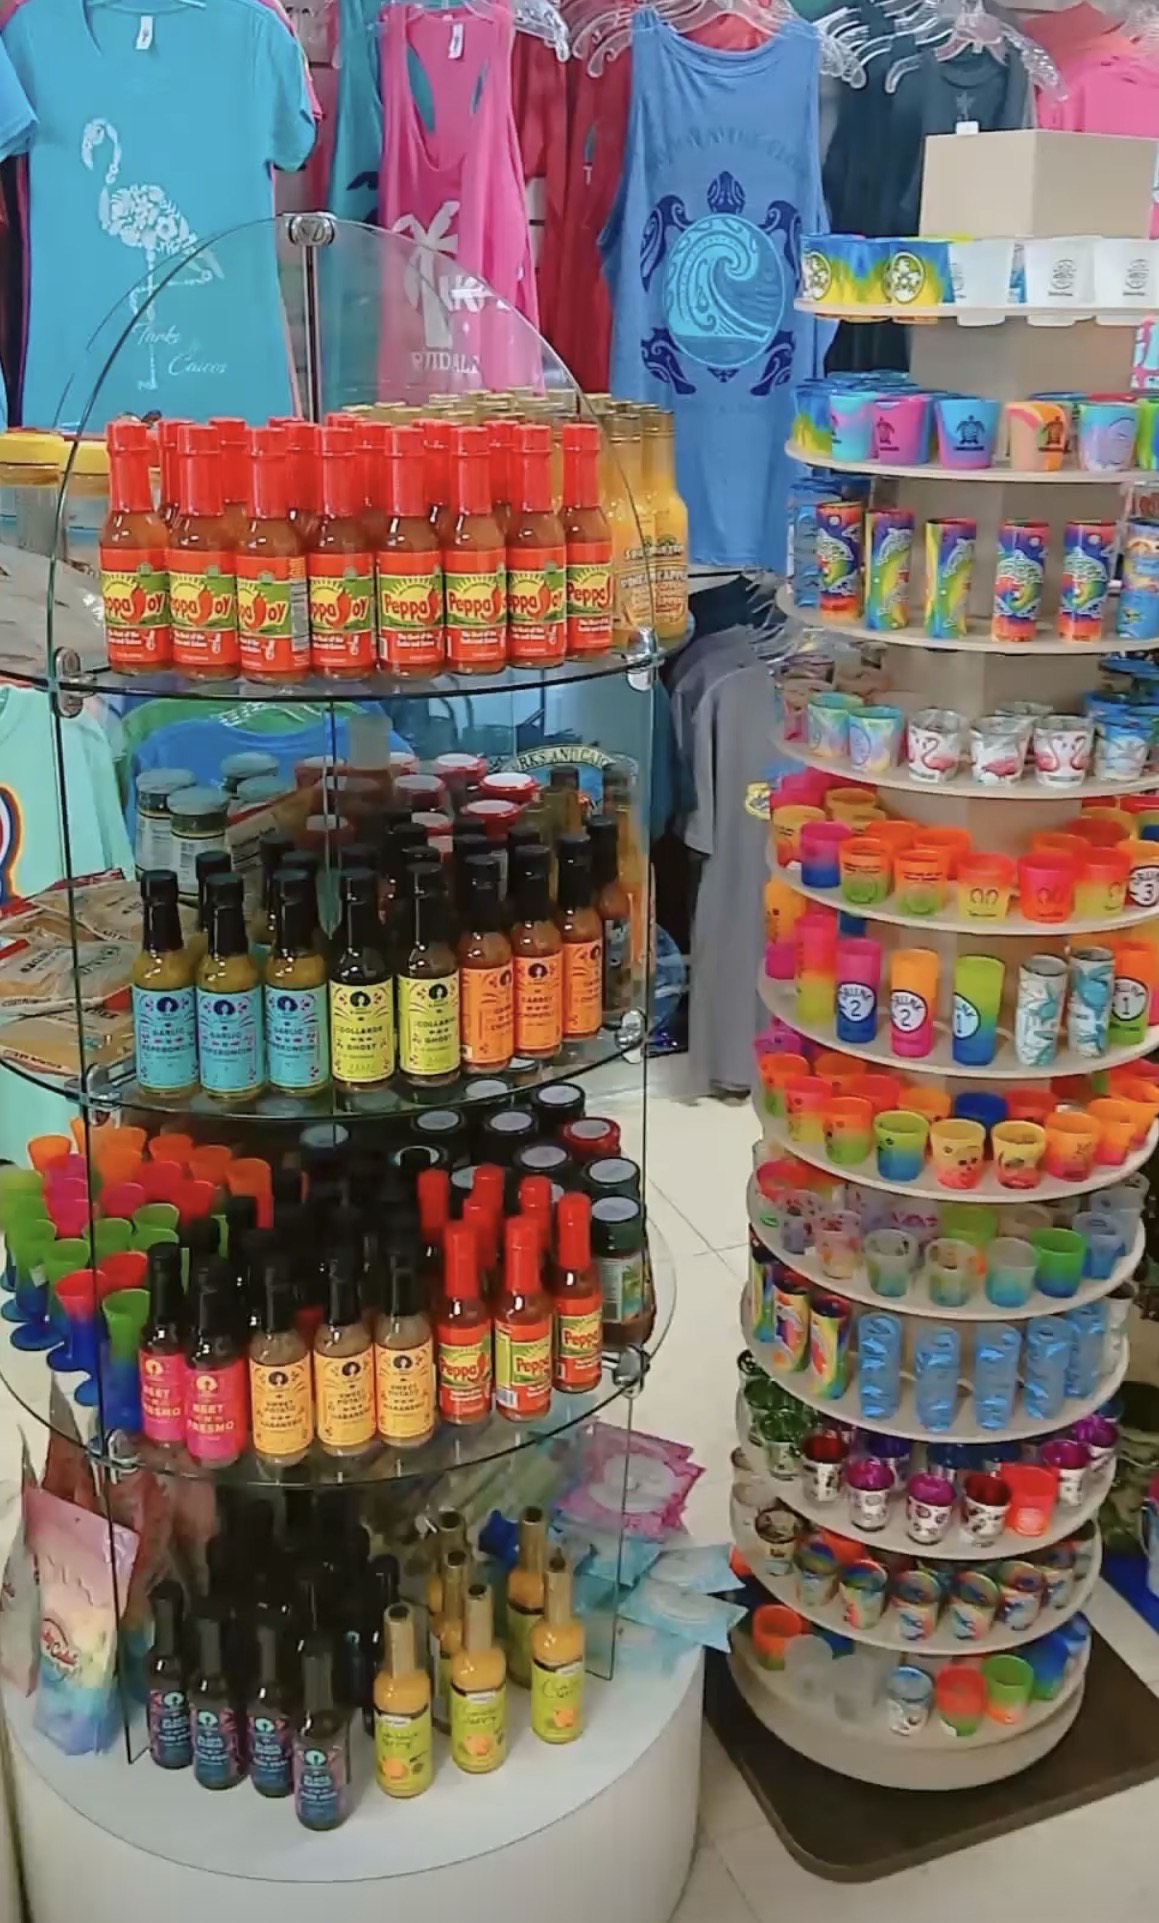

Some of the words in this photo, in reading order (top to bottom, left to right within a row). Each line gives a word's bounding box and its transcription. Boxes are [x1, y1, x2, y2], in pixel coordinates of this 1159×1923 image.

[168, 353, 228, 377] Caicos
[383, 592, 429, 620] Peppa
[448, 591, 491, 618] Peppa
[850, 999, 862, 1017] 2
[900, 1008, 912, 1027] 2
[192, 1403, 223, 1413] BEET
